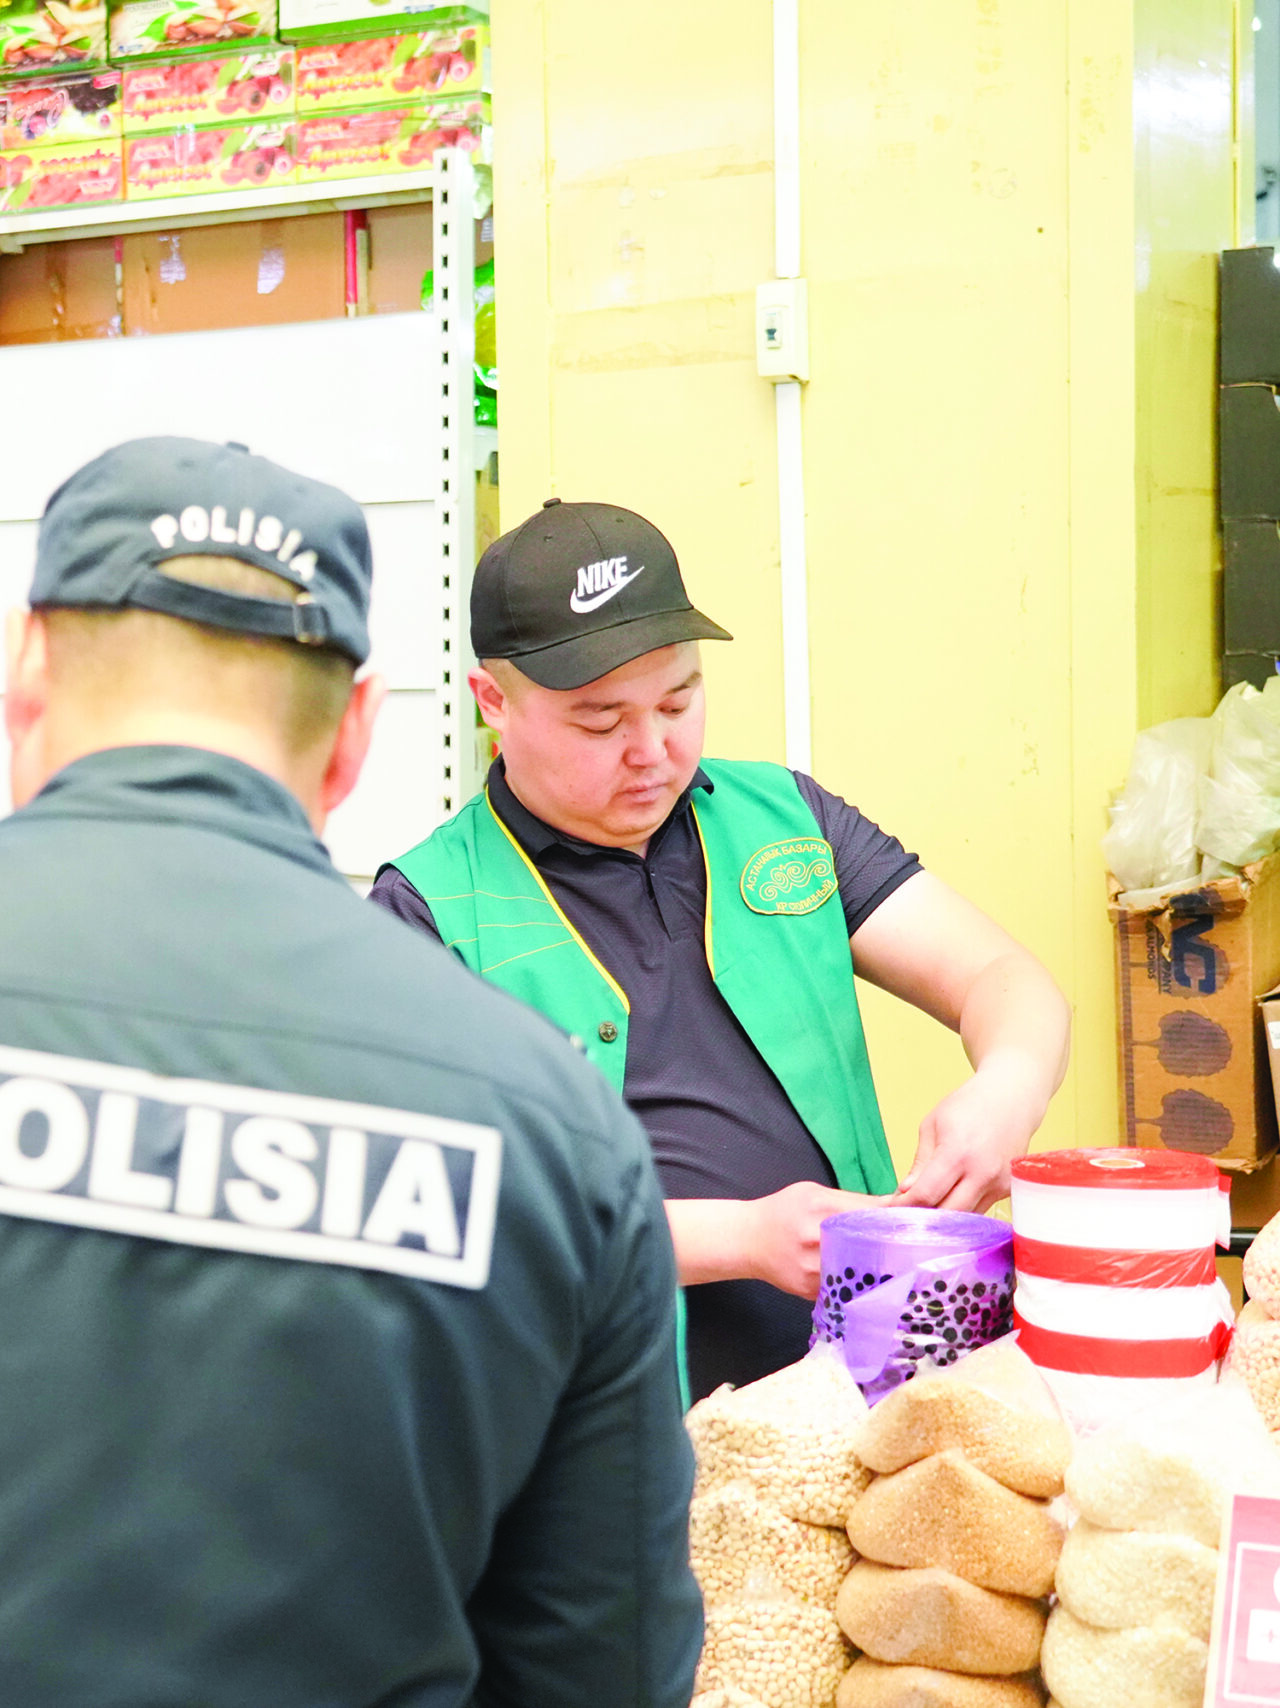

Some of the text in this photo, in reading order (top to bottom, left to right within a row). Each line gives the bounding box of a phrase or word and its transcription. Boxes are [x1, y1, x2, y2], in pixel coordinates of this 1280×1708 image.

[150, 505, 318, 582] POLISIA
[577, 556, 628, 597] NIKE
[781, 843, 827, 855] БАЗАРЫ
